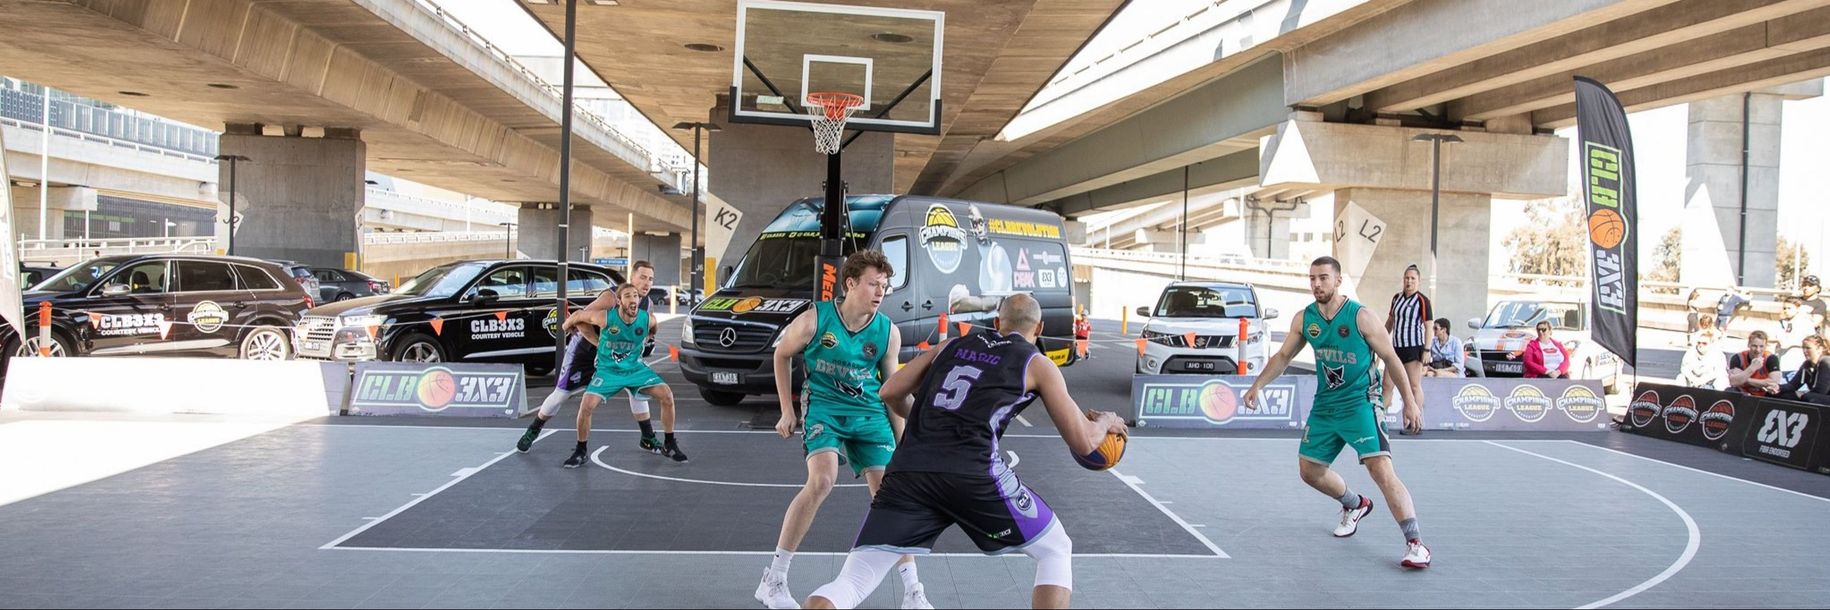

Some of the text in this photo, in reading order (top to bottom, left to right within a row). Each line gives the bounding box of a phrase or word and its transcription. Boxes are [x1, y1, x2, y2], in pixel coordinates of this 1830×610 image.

[1591, 149, 1618, 208] CLB
[714, 207, 738, 230] K2
[921, 225, 966, 247] CHAMPIONS
[1335, 220, 1345, 242] L2
[1359, 219, 1381, 243] L2
[471, 318, 525, 332] CLB3X3
[471, 332, 501, 340] COURTESY
[360, 375, 417, 401] CLB
[455, 377, 511, 402] 3X3
[933, 365, 983, 410] 5
[1145, 389, 1198, 414] CLB
[1455, 396, 1499, 408] CHAMPIONS
[1506, 396, 1550, 408] CHAMPIONS
[1558, 397, 1602, 408] CHAMPIONS
